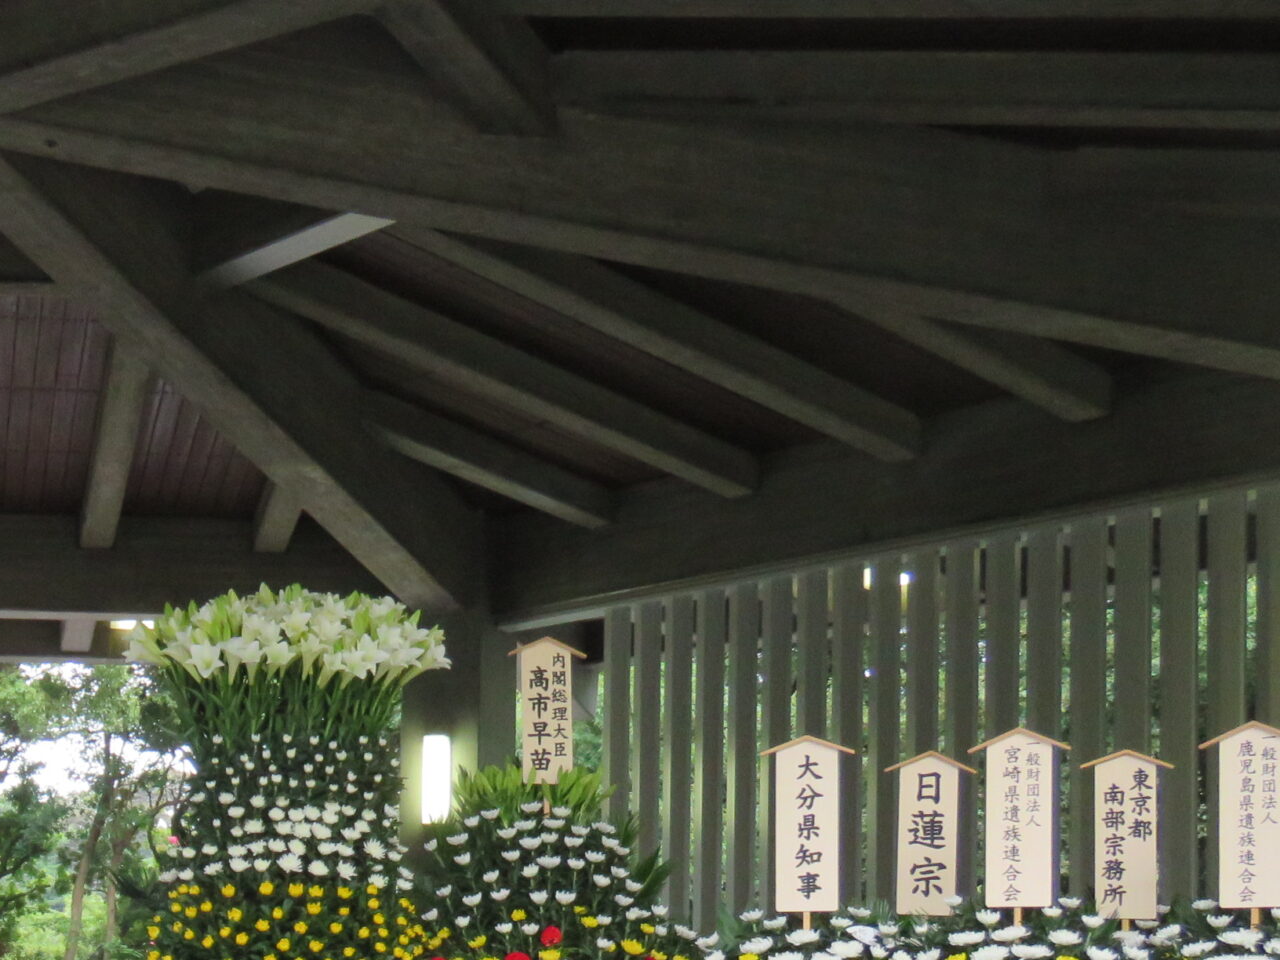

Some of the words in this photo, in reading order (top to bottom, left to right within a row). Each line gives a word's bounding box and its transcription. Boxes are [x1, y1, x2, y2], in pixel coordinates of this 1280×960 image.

[527, 665, 553, 771] 高市早苗
[551, 652, 569, 757] 内閣総理大臣
[794, 754, 825, 900] 大分県知事
[907, 771, 947, 898] 日蓮宗
[1002, 745, 1023, 902] 宮崎県遺族連合会
[1025, 741, 1042, 828] 一般財団法人
[1127, 767, 1153, 842] 東京都
[1236, 739, 1257, 903] 鹿児島県遺族連合会
[1260, 734, 1279, 825] 一般財団法人
[1101, 783, 1128, 906] 南部宗務所
